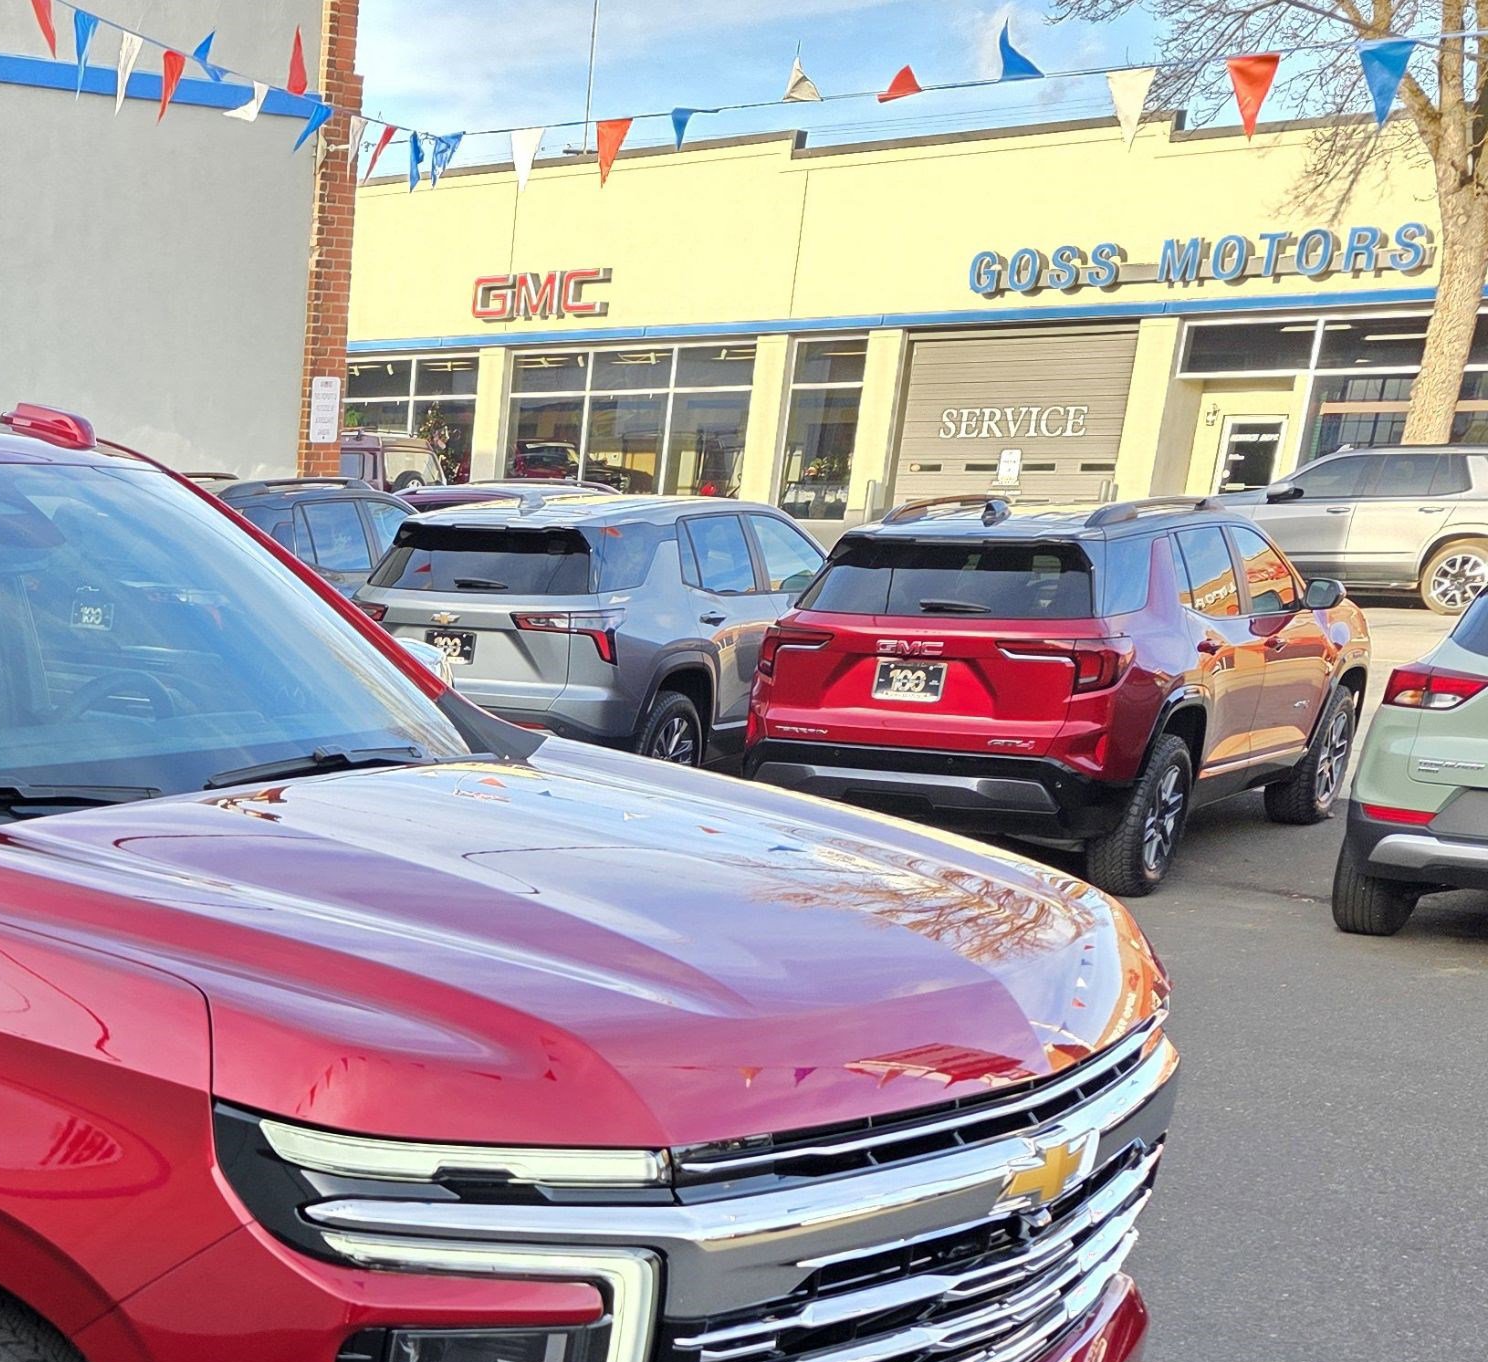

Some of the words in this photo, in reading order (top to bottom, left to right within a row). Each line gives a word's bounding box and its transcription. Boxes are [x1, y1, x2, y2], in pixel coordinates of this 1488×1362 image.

[969, 242, 1120, 295] GOSS
[1158, 221, 1429, 282] MOTORS
[472, 268, 604, 320] GMC
[938, 405, 1089, 439] SERVICE
[875, 639, 945, 656] GMC
[889, 669, 927, 692] 100
